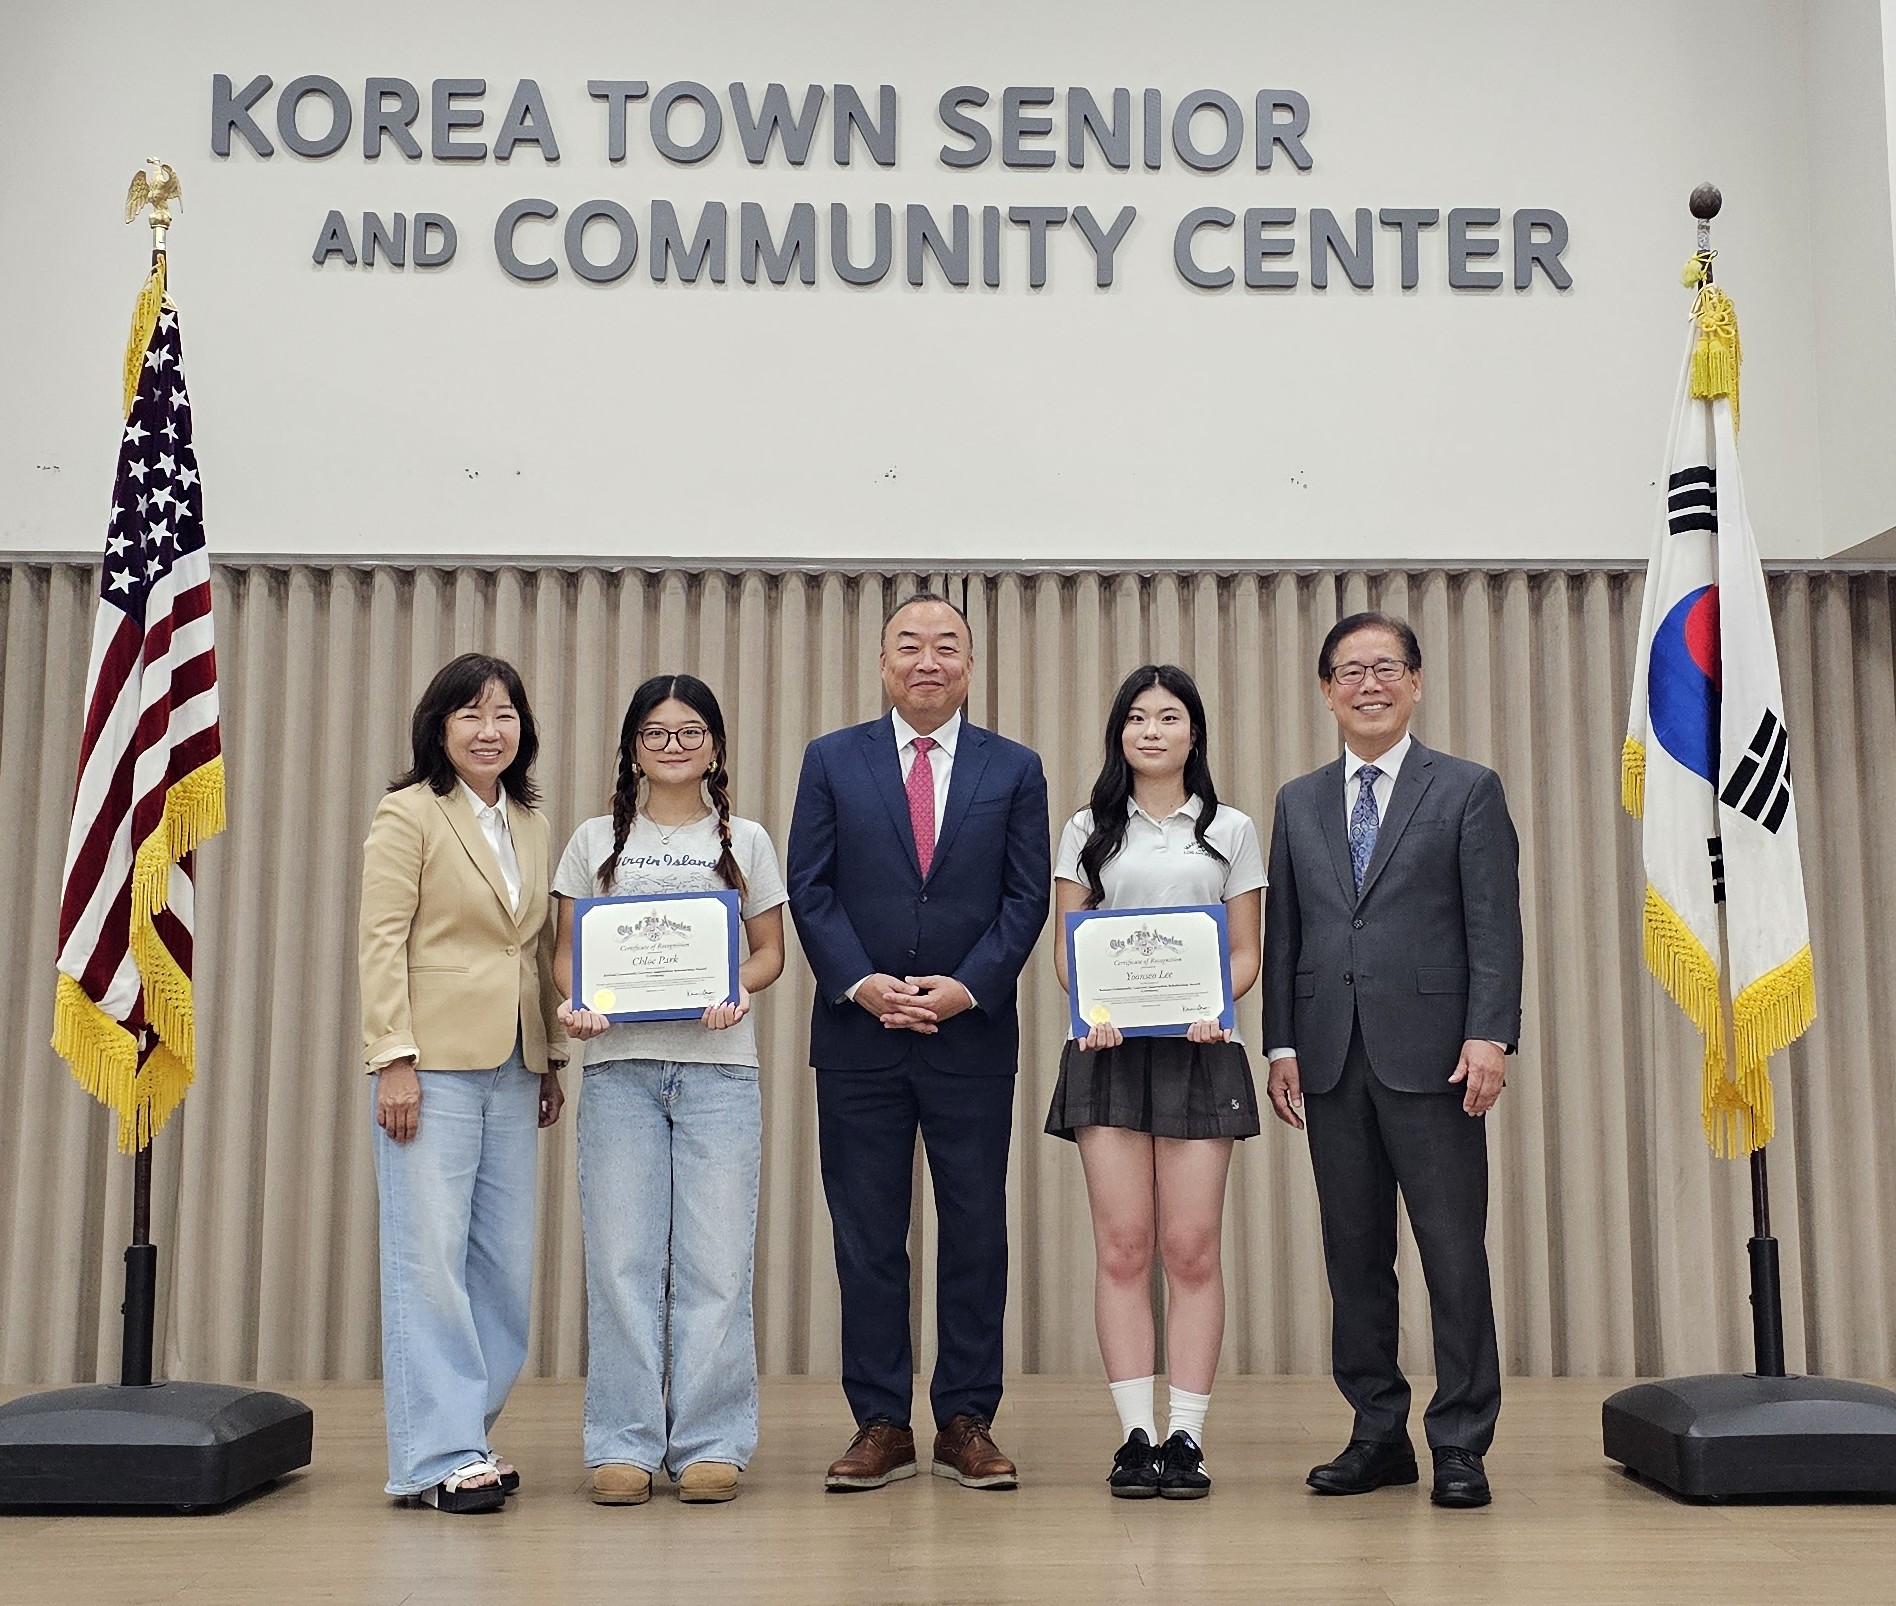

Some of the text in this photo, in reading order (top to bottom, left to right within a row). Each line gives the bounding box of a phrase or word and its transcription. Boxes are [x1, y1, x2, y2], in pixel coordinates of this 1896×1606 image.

[211, 74, 1313, 171] KOREA TOWN SENIOR
[312, 199, 1573, 289] AND COMMUNITY CENTER
[663, 854, 717, 869] Island
[1109, 939, 1125, 950] City
[1151, 929, 1184, 946] Angeles
[658, 954, 679, 965] Park
[1159, 970, 1173, 979] Lee
